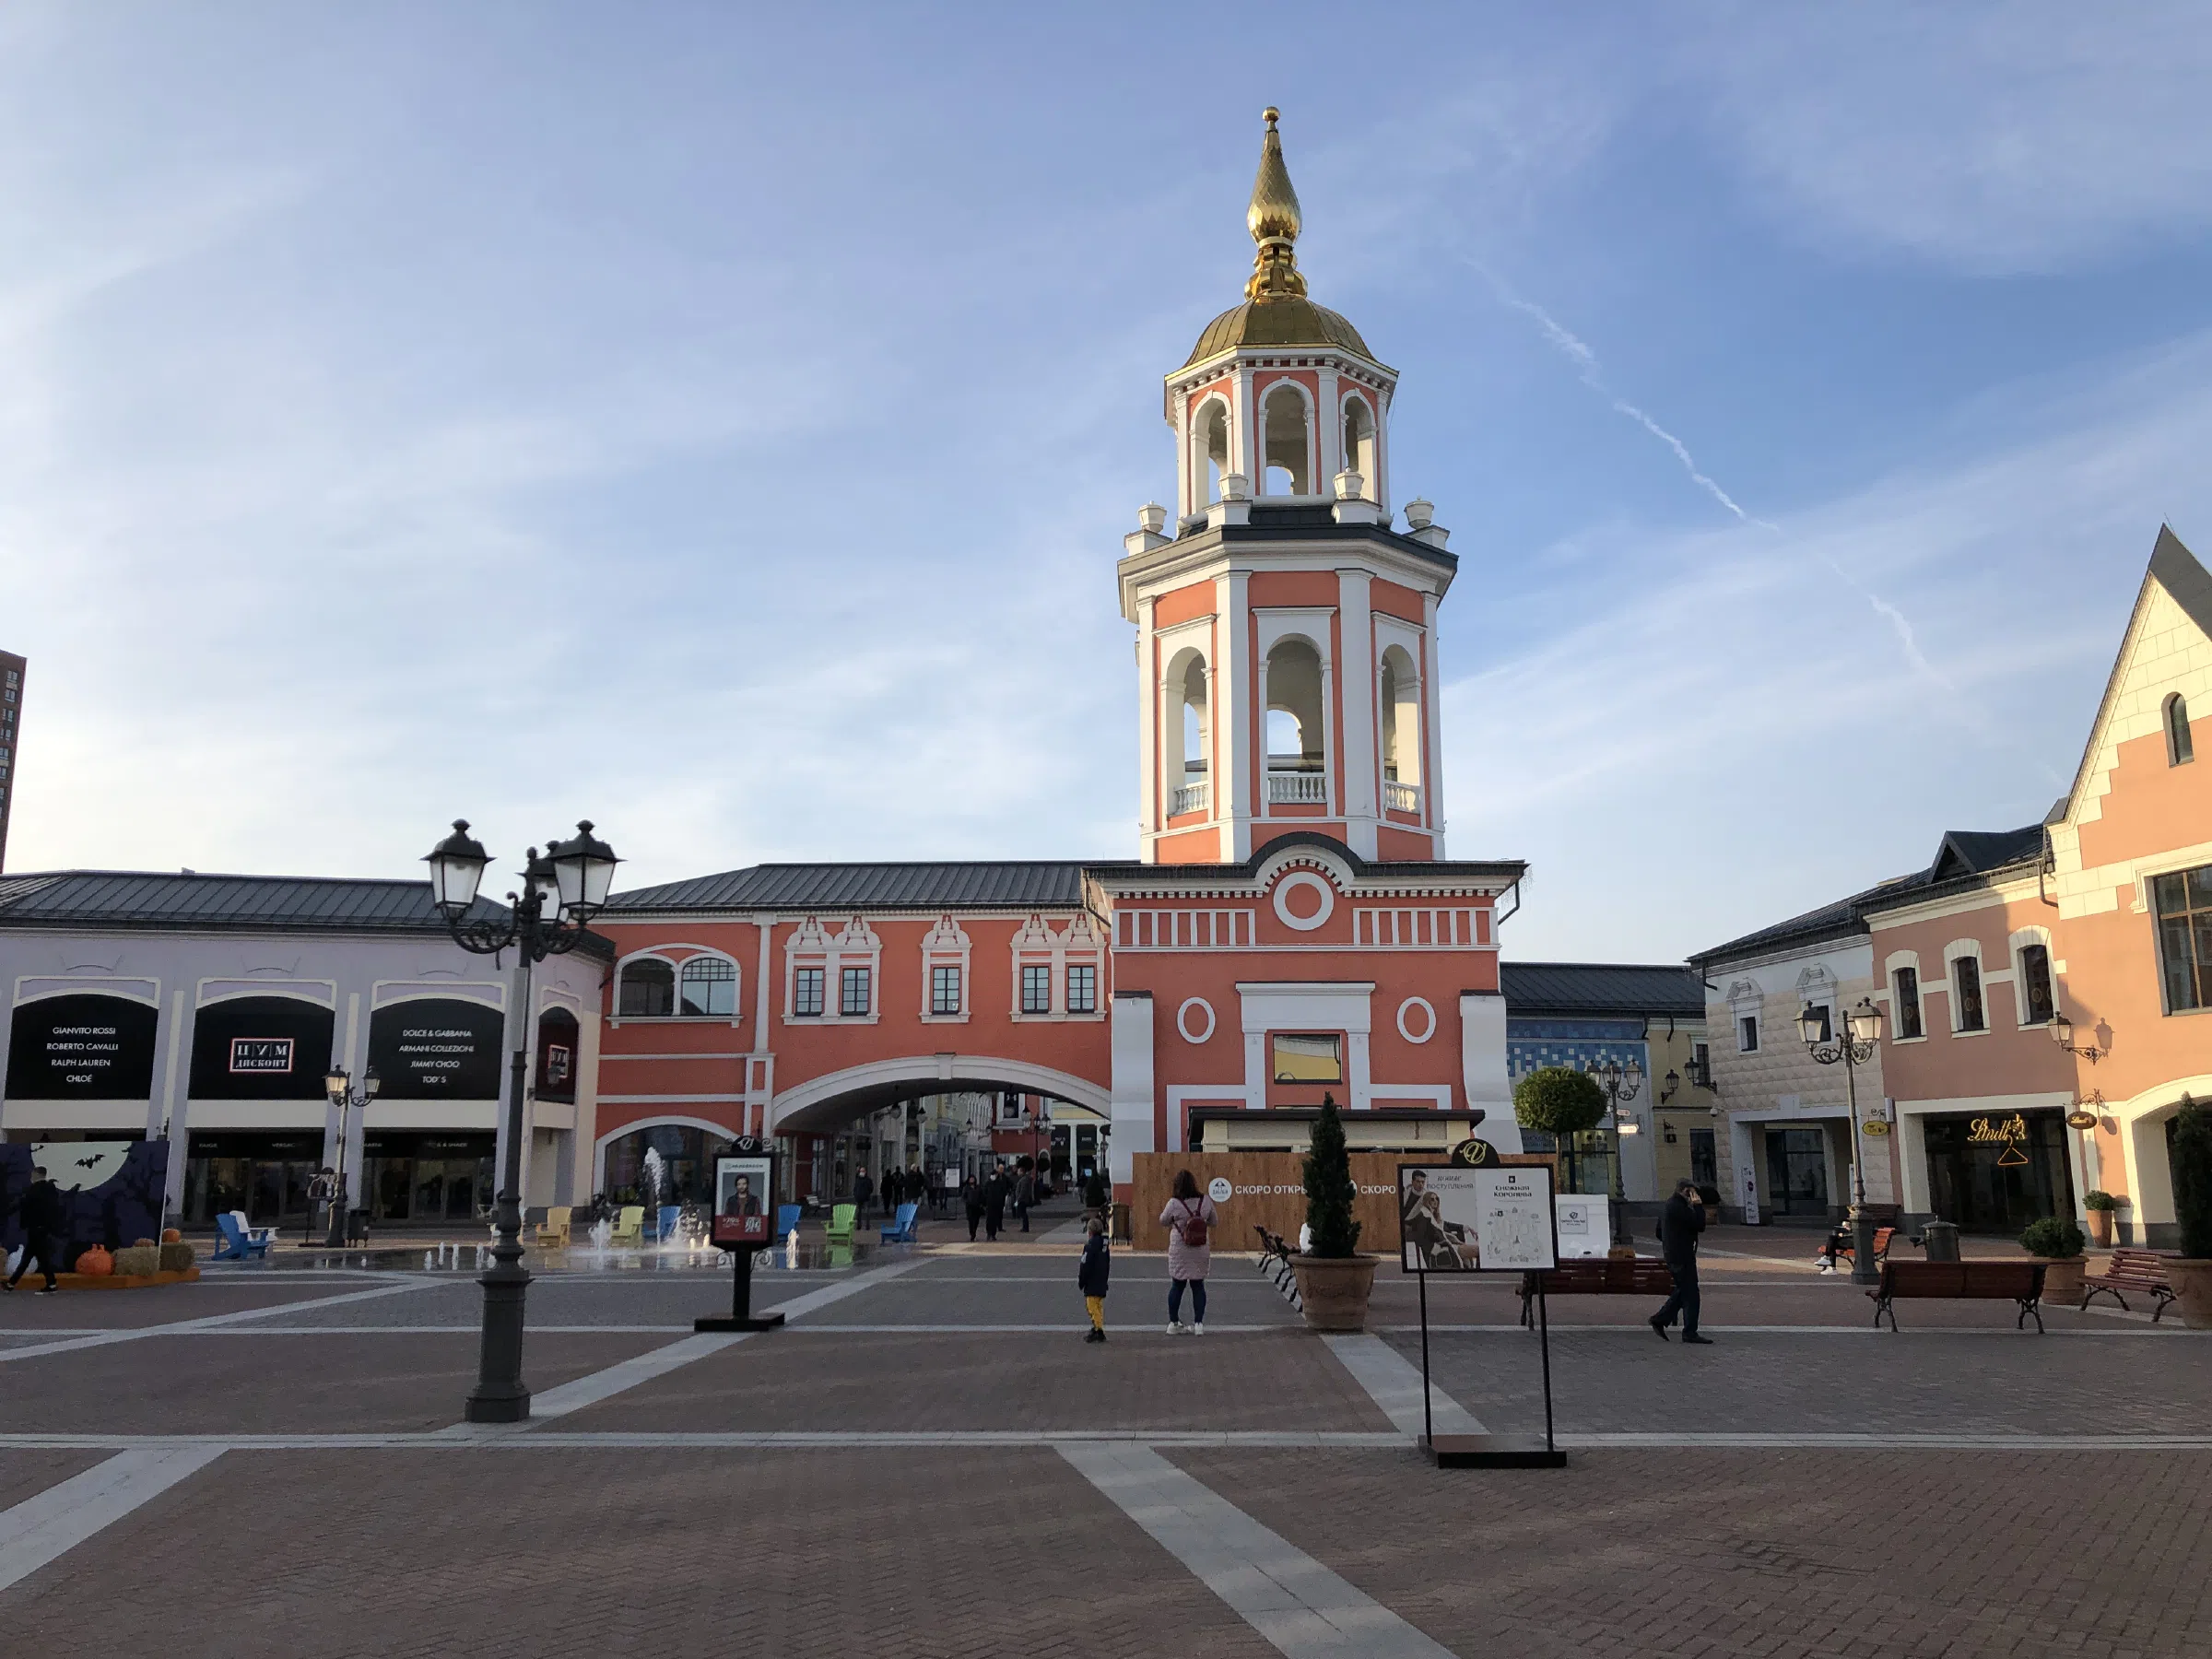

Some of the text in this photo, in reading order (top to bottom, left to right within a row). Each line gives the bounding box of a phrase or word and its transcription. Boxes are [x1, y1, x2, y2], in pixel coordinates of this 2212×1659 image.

[53, 1027, 116, 1035] GIANVITO ROSSI
[434, 1030, 473, 1038] GABBANA
[46, 1042, 119, 1051] ROBERTO CAVALLI
[398, 1044, 474, 1053] ARMANI COLLEZIONI
[410, 1060, 461, 1068] JIMMY CHOO
[65, 1073, 92, 1083] CHLOÉ
[1967, 1117, 2011, 1142] Lindt
[1235, 1185, 1271, 1194] СКОРО
[1360, 1185, 1396, 1194] СКОРО
